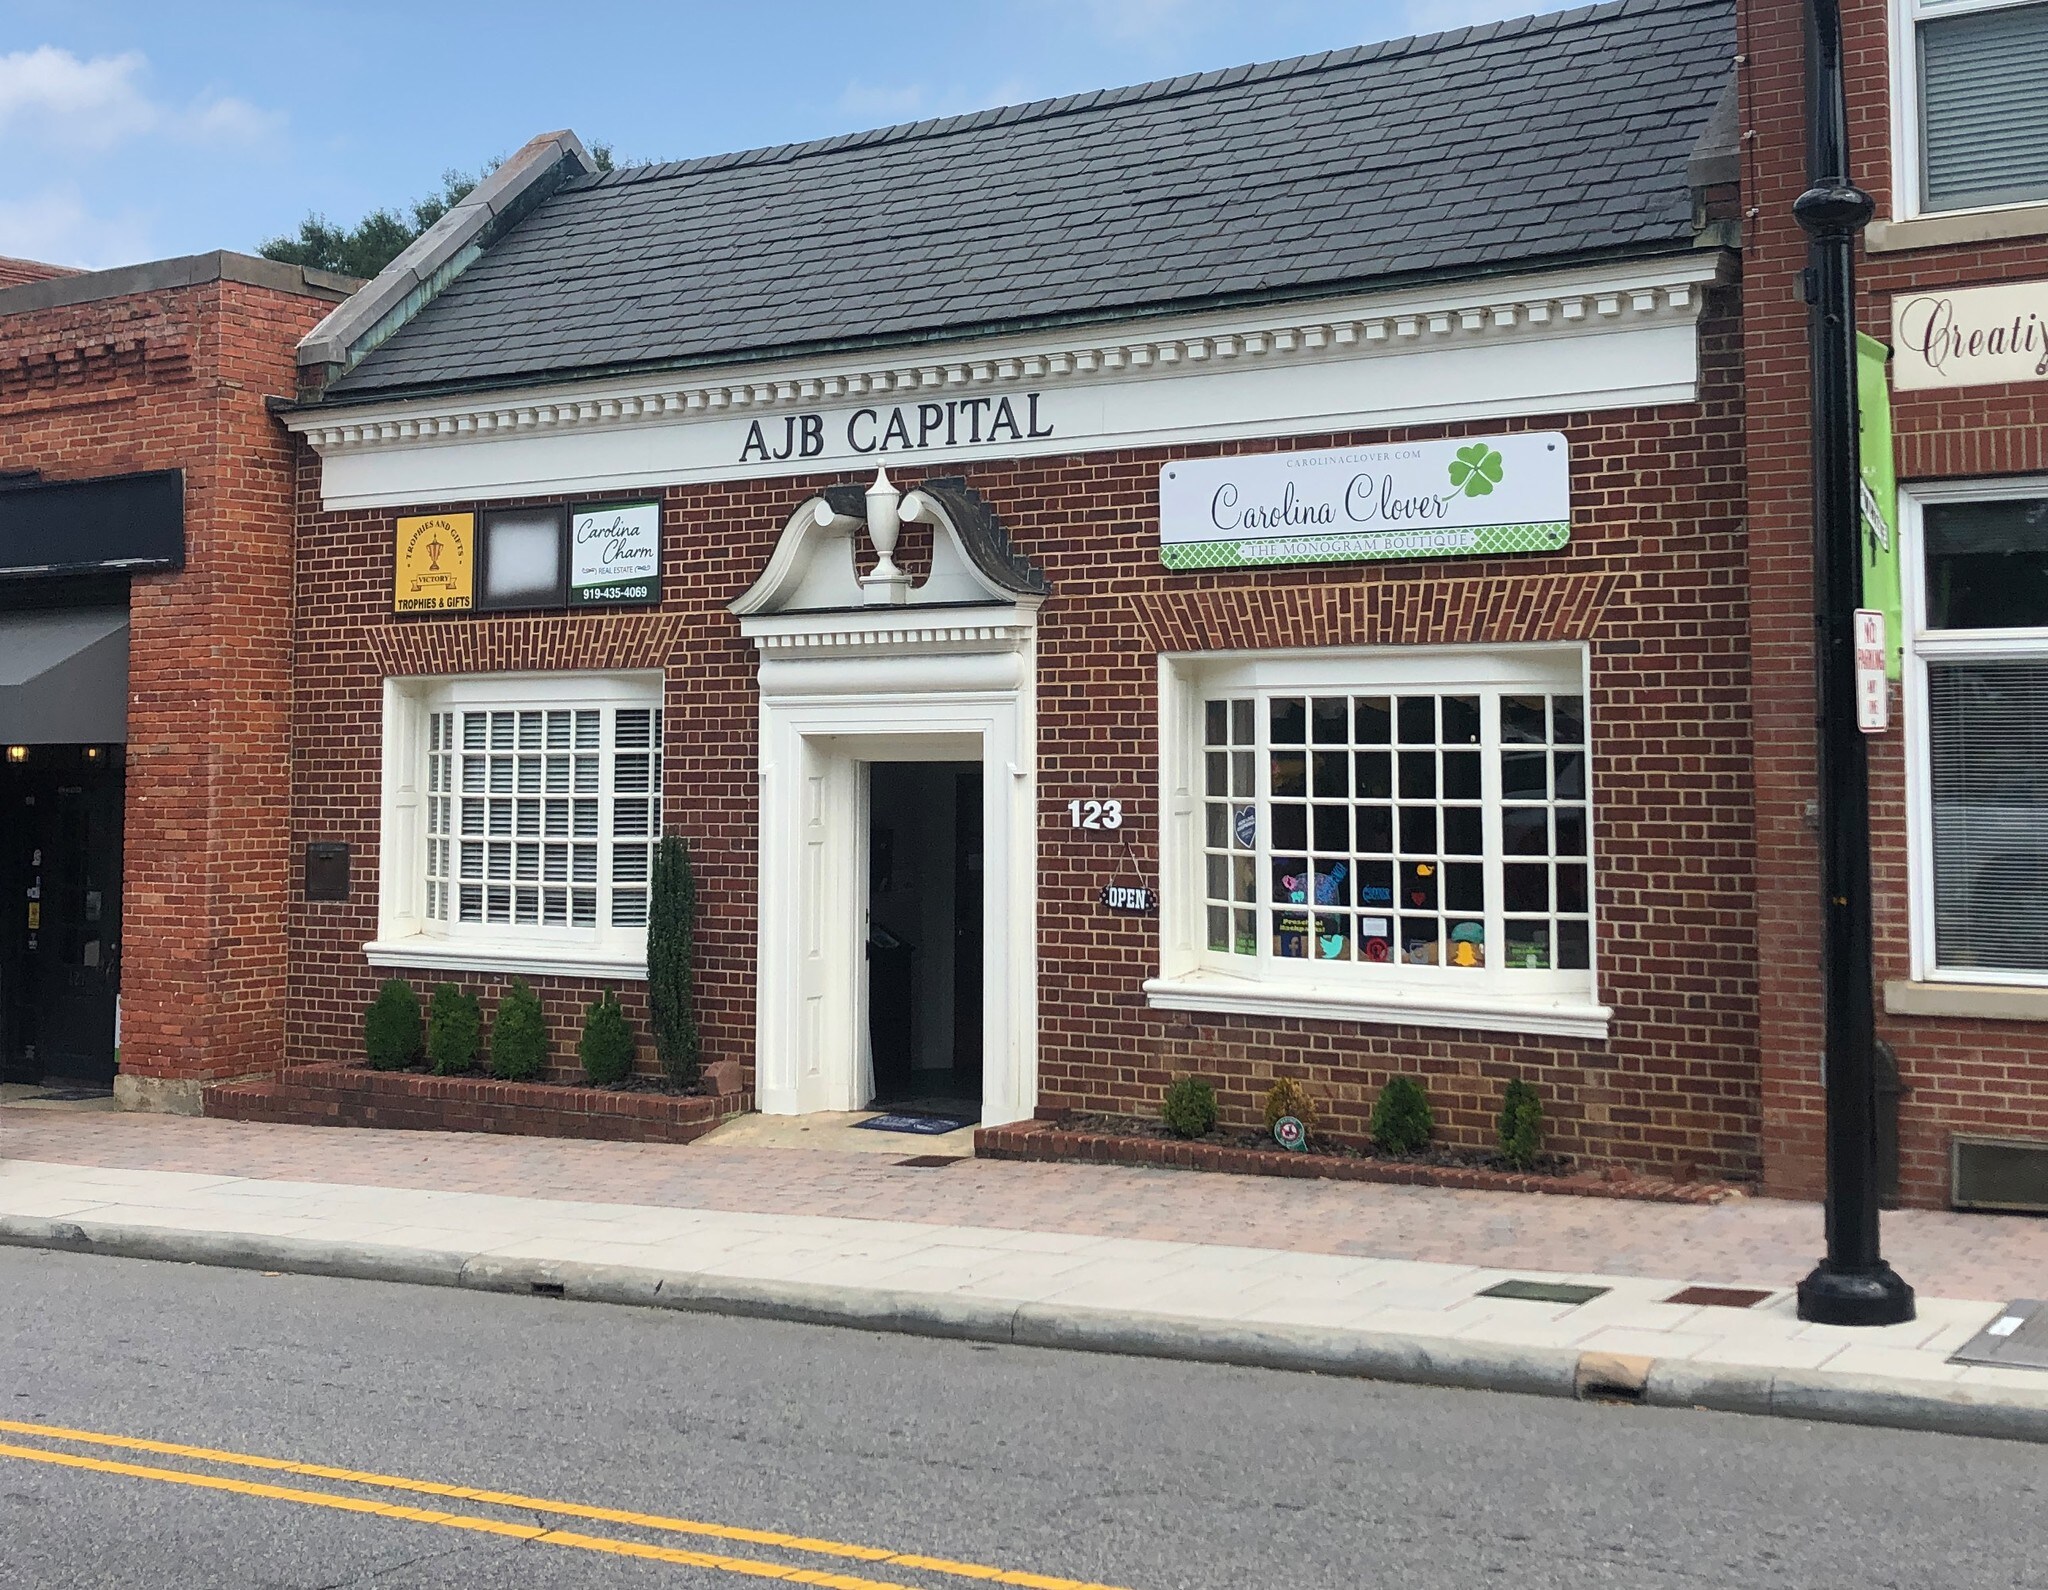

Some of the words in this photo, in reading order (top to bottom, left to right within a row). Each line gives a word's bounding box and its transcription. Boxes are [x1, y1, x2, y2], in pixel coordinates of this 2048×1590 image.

[739, 414, 825, 462] AJB
[847, 393, 1055, 453] CAPITAL
[1286, 450, 1422, 468] CAROLINACLOVERCOM
[1211, 482, 1337, 530] Carolina
[1344, 473, 1450, 522] Clover
[406, 519, 434, 560] TROPHIES
[434, 519, 451, 531] AND
[450, 528, 464, 557] GIFTS
[577, 516, 640, 544] Carolina
[602, 538, 654, 564] Charm
[1250, 544, 1278, 557] THE
[1283, 539, 1378, 554] MONOGRAM
[1384, 533, 1467, 549] BOUTIQUE
[418, 575, 449, 583] VICTORY
[598, 567, 612, 575] REAL
[613, 565, 634, 574] ESTATE
[398, 597, 437, 611] TROPHIES
[439, 597, 444, 608] &
[446, 595, 470, 608] GIFTS
[583, 585, 648, 600] 919-435-4069
[1067, 799, 1123, 830] 123
[1109, 887, 1146, 909] OPEN
